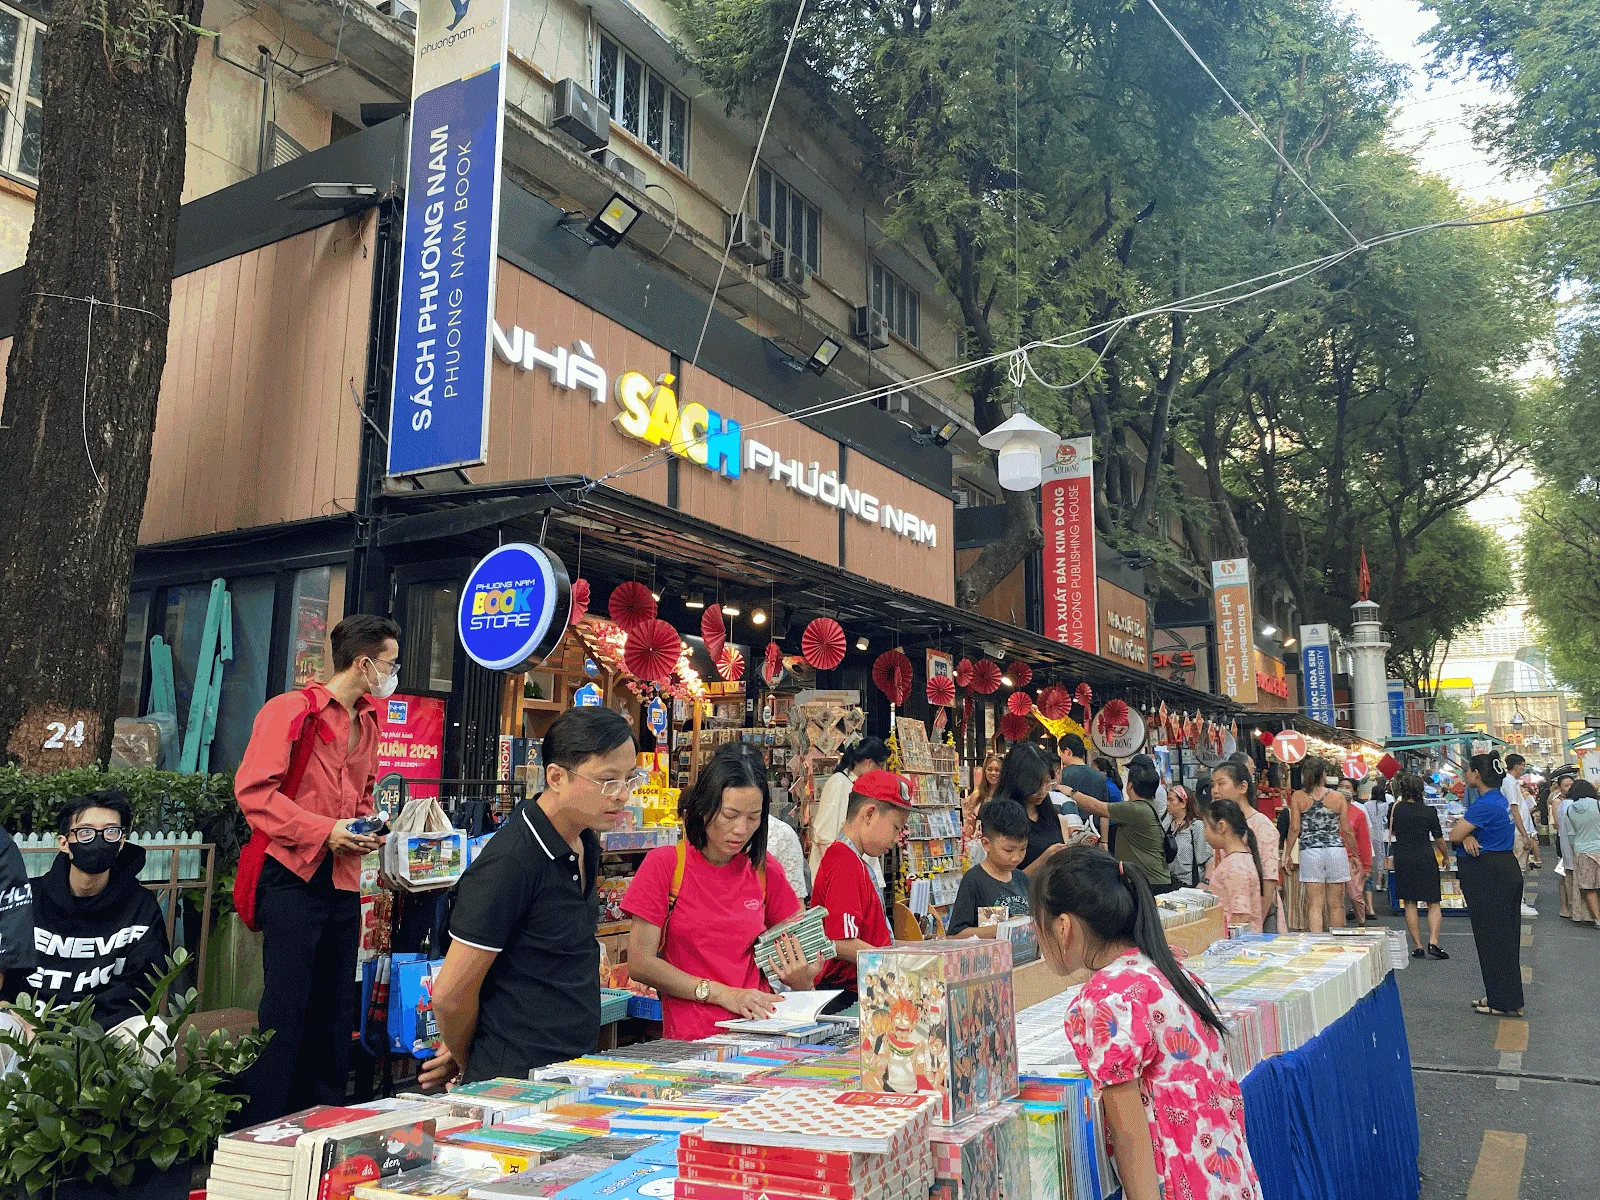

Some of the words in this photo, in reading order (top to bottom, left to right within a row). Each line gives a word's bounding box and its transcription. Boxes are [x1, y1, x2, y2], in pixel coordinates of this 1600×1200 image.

[427, 124, 449, 197] NAM
[455, 140, 472, 211] BOOK
[417, 200, 444, 333] PHƯƠNG
[450, 220, 467, 278] NAM
[444, 288, 463, 398] PHUONG
[410, 334, 436, 431] SÁCH
[493, 319, 607, 403] NHÀ
[611, 371, 741, 480] SÁCH
[881, 504, 937, 548] NAM
[1068, 484, 1080, 524] HOUSE
[1055, 530, 1066, 553] KIM
[1069, 525, 1082, 588] PUBLISHING
[471, 587, 534, 616] BOOK
[475, 580, 513, 591] PHUONG
[514, 579, 536, 587] NAM
[469, 613, 531, 630] STORE
[1072, 591, 1083, 628] DONG
[1055, 623, 1069, 644] HÀ
[1308, 650, 1316, 667] SEN
[1310, 669, 1318, 688] HOA
[1317, 650, 1327, 692] UNIVERSITY
[44, 720, 85, 749] 24
[377, 740, 407, 758] XUÂN
[409, 743, 439, 759] 2024
[501, 743, 510, 793] MONO
